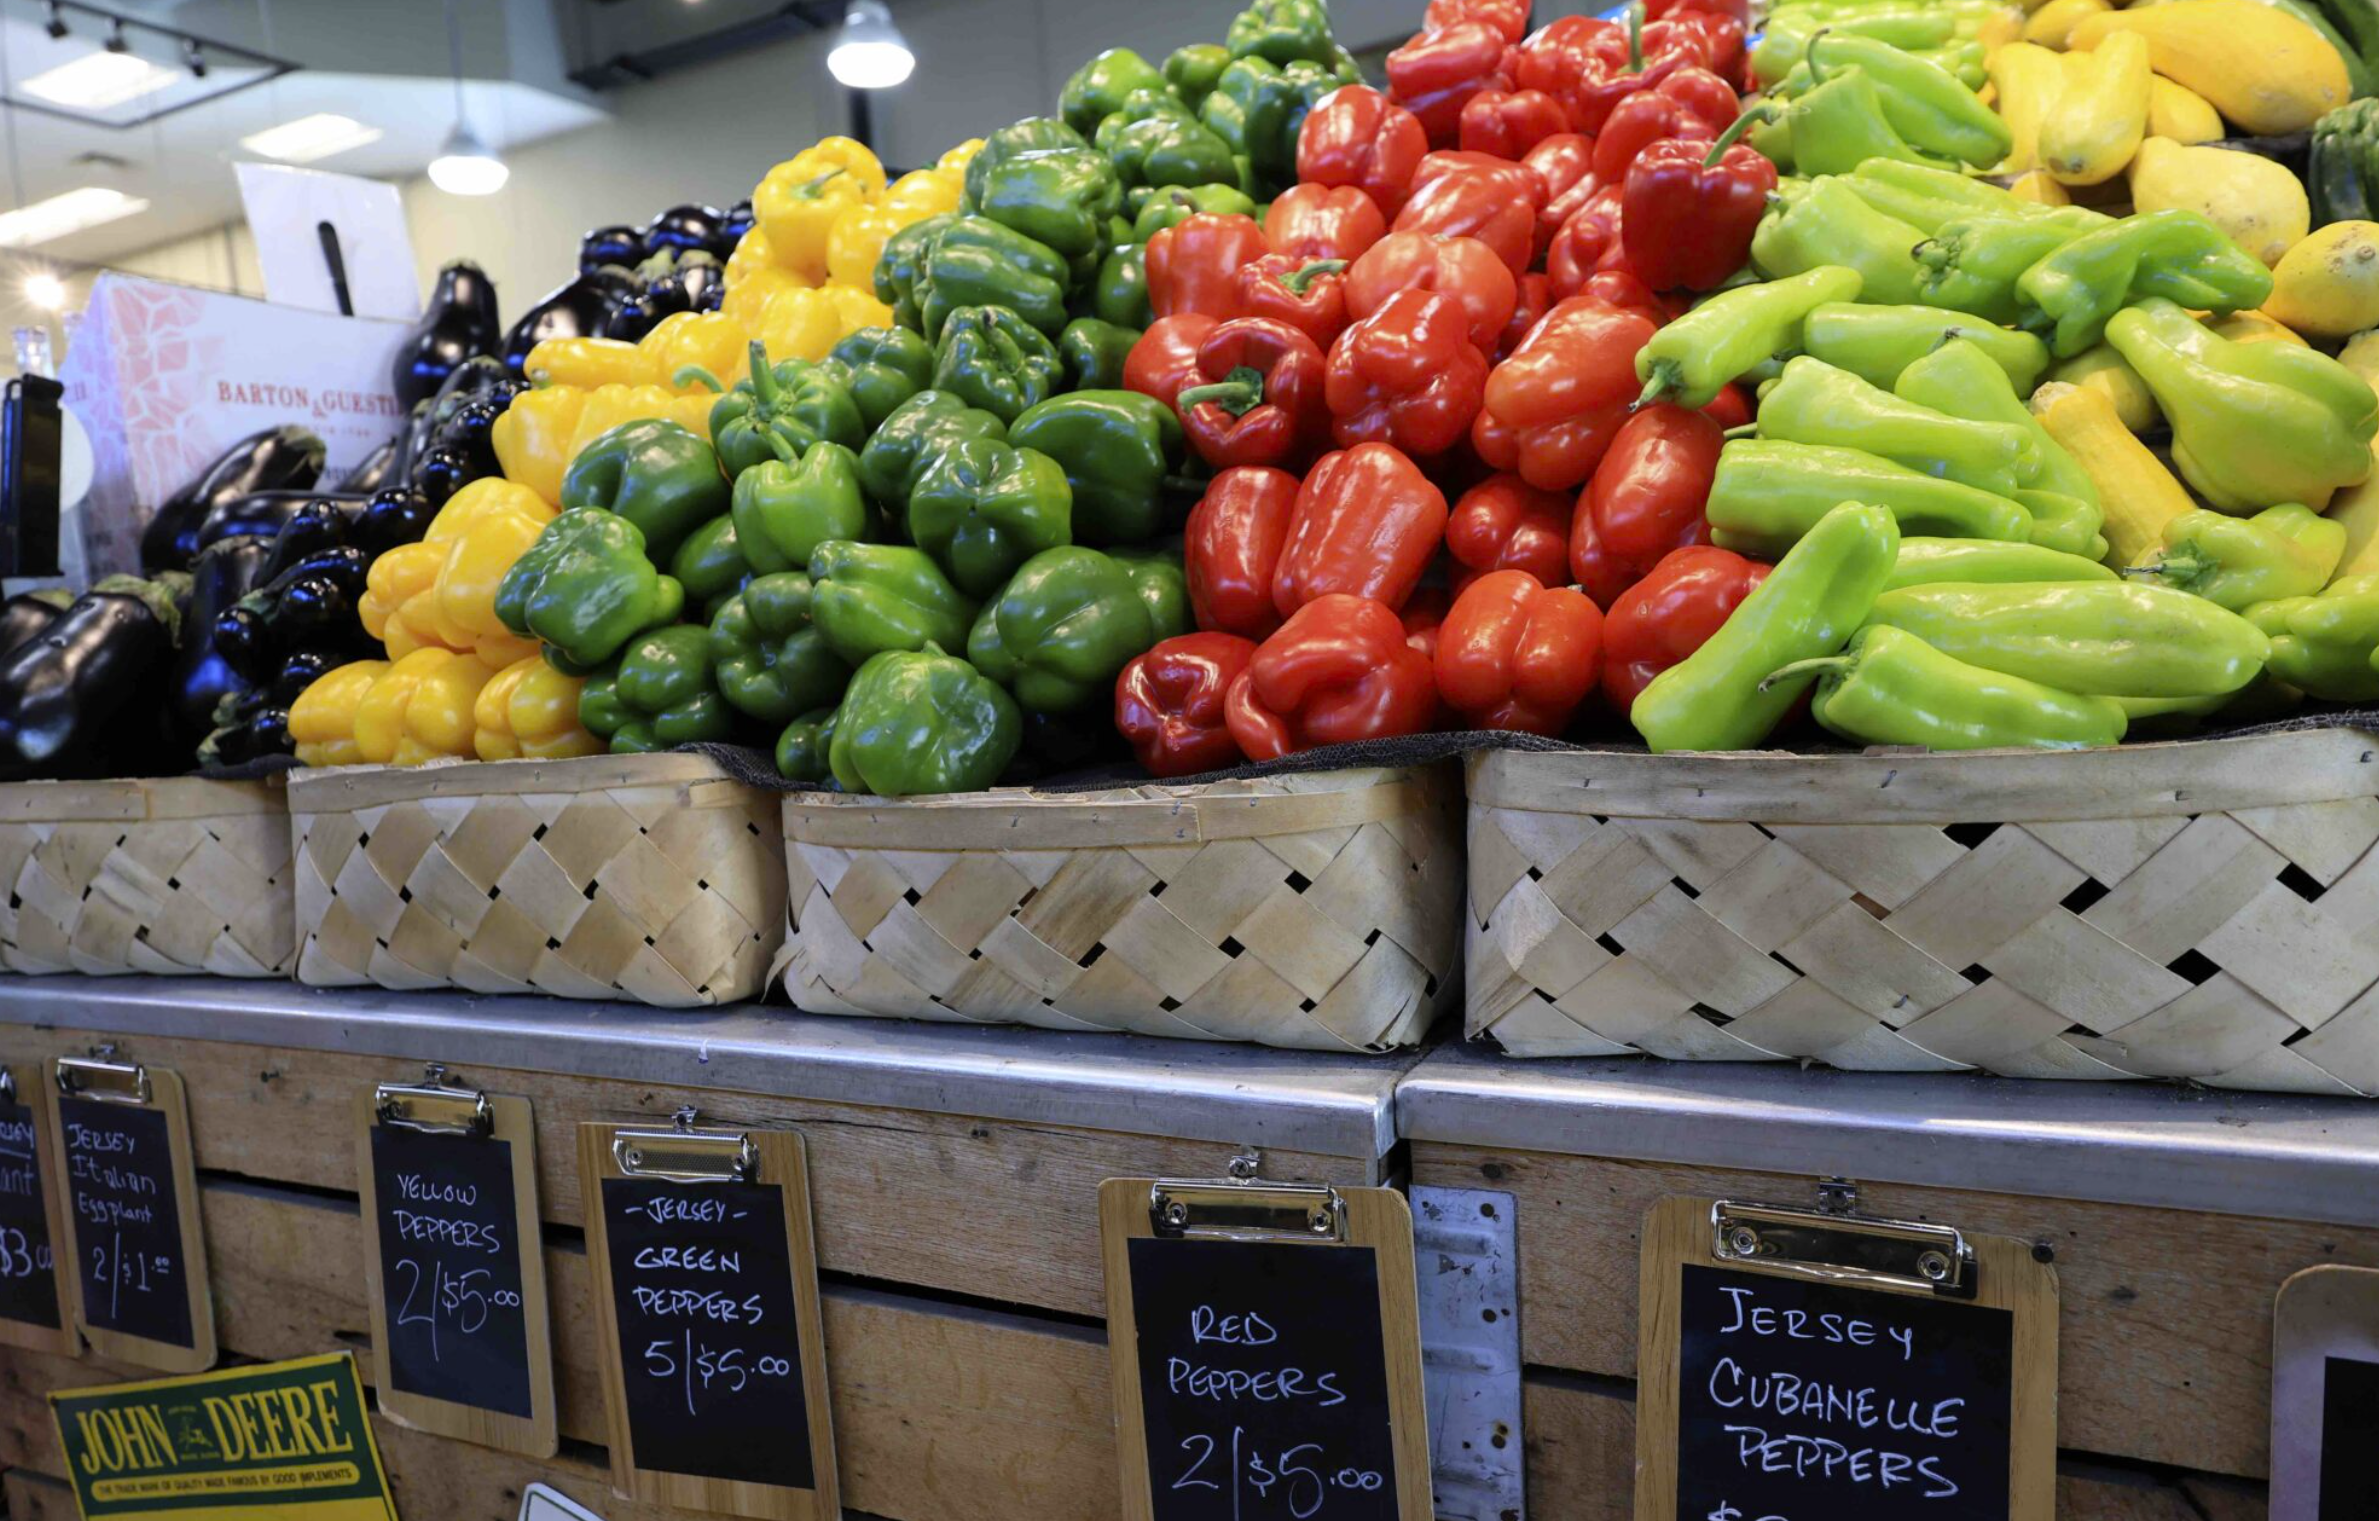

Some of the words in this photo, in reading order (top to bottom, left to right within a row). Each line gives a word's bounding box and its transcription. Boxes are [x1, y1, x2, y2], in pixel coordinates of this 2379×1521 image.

[218, 381, 309, 408] BARTON
[68, 1123, 135, 1154] JERSEY
[72, 1154, 156, 1195] Italian
[397, 1174, 477, 1206] YELLOW
[79, 1192, 153, 1225] Eggplant
[393, 1210, 500, 1254] PEPPERS
[634, 1246, 741, 1273] GREEN
[632, 1286, 764, 1325] PEPPERS
[1191, 1304, 1277, 1345] RED
[1718, 1286, 1912, 1360] JERSEY
[1168, 1356, 1347, 1407] PEPPERS
[1709, 1357, 1965, 1438] CUBANELLE
[75, 1403, 178, 1475] JOHN
[202, 1379, 354, 1463] DEERE
[162, 1480, 172, 1490] OF
[175, 1478, 203, 1491] QUALITY
[205, 1476, 225, 1488] MADE
[227, 1474, 258, 1487] FAMOUS
[260, 1473, 270, 1486] BY
[273, 1472, 296, 1485] GOOD
[300, 1468, 353, 1484] IMPLEMENTS
[1723, 1424, 1959, 1498] PEPPERS
